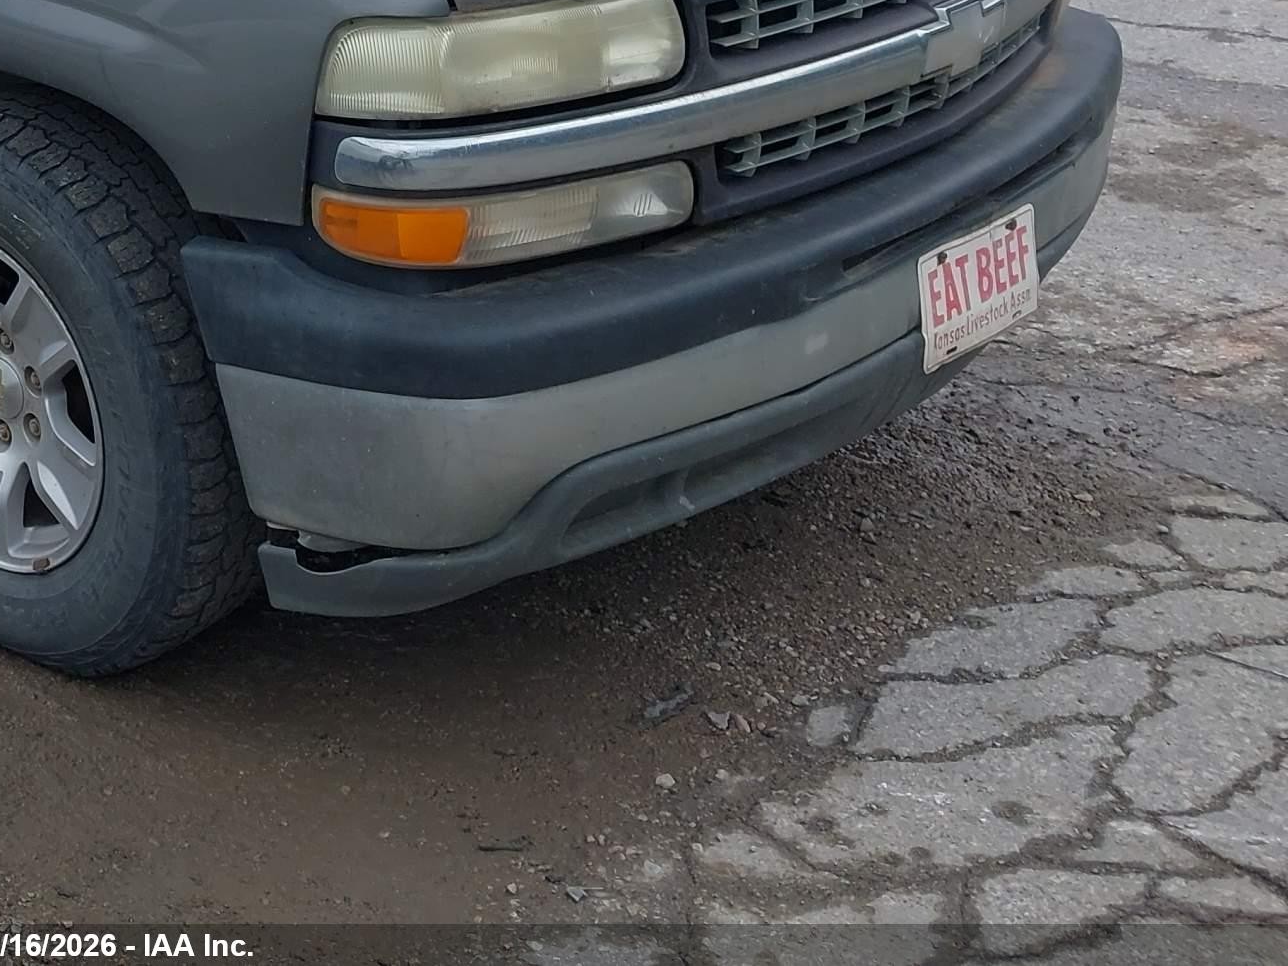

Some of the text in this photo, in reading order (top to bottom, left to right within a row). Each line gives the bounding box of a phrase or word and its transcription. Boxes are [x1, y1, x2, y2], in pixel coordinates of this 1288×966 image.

[927, 225, 1029, 328] EAT BEEF
[966, 295, 1010, 335] Livestock
